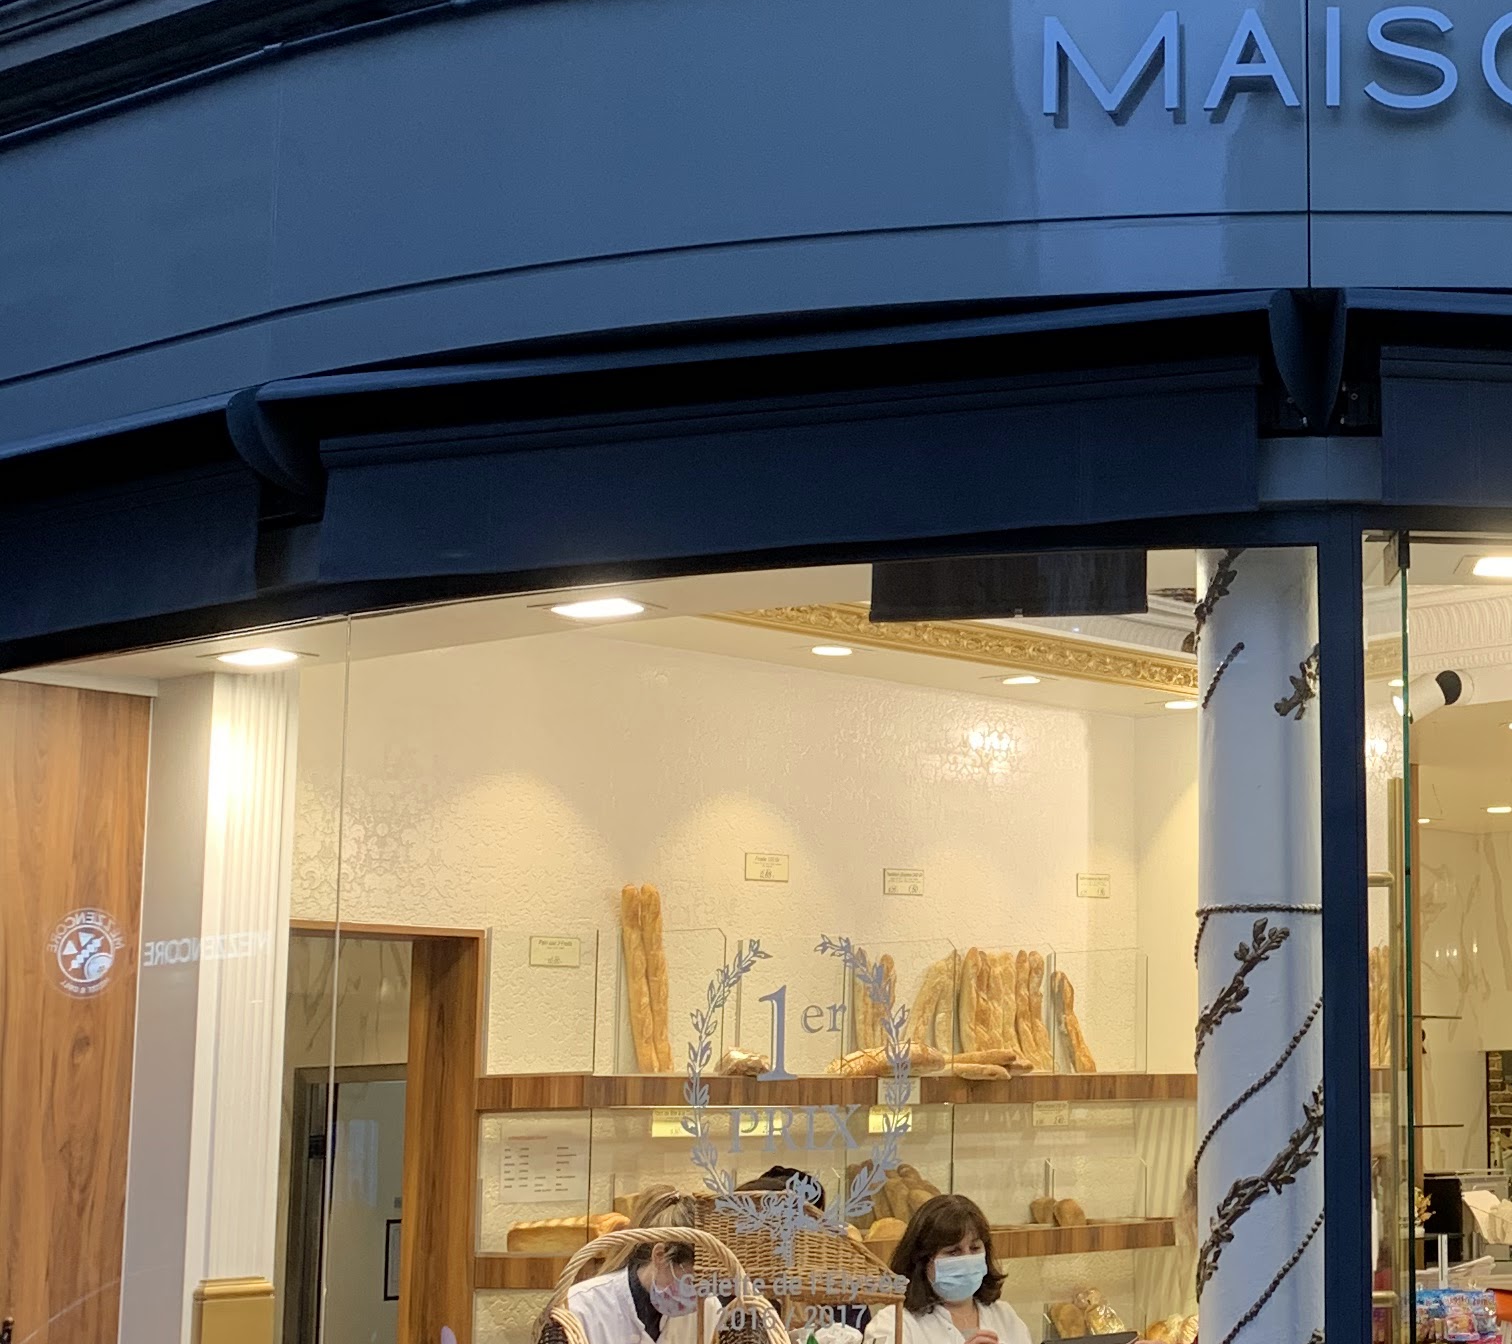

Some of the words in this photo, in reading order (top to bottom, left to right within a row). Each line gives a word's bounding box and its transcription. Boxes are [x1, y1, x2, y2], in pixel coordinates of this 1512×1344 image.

[757, 984, 847, 1082] 1er
[728, 1104, 862, 1154] PRIX
[772, 1271, 801, 1297] de
[803, 1304, 868, 1330] 2017
